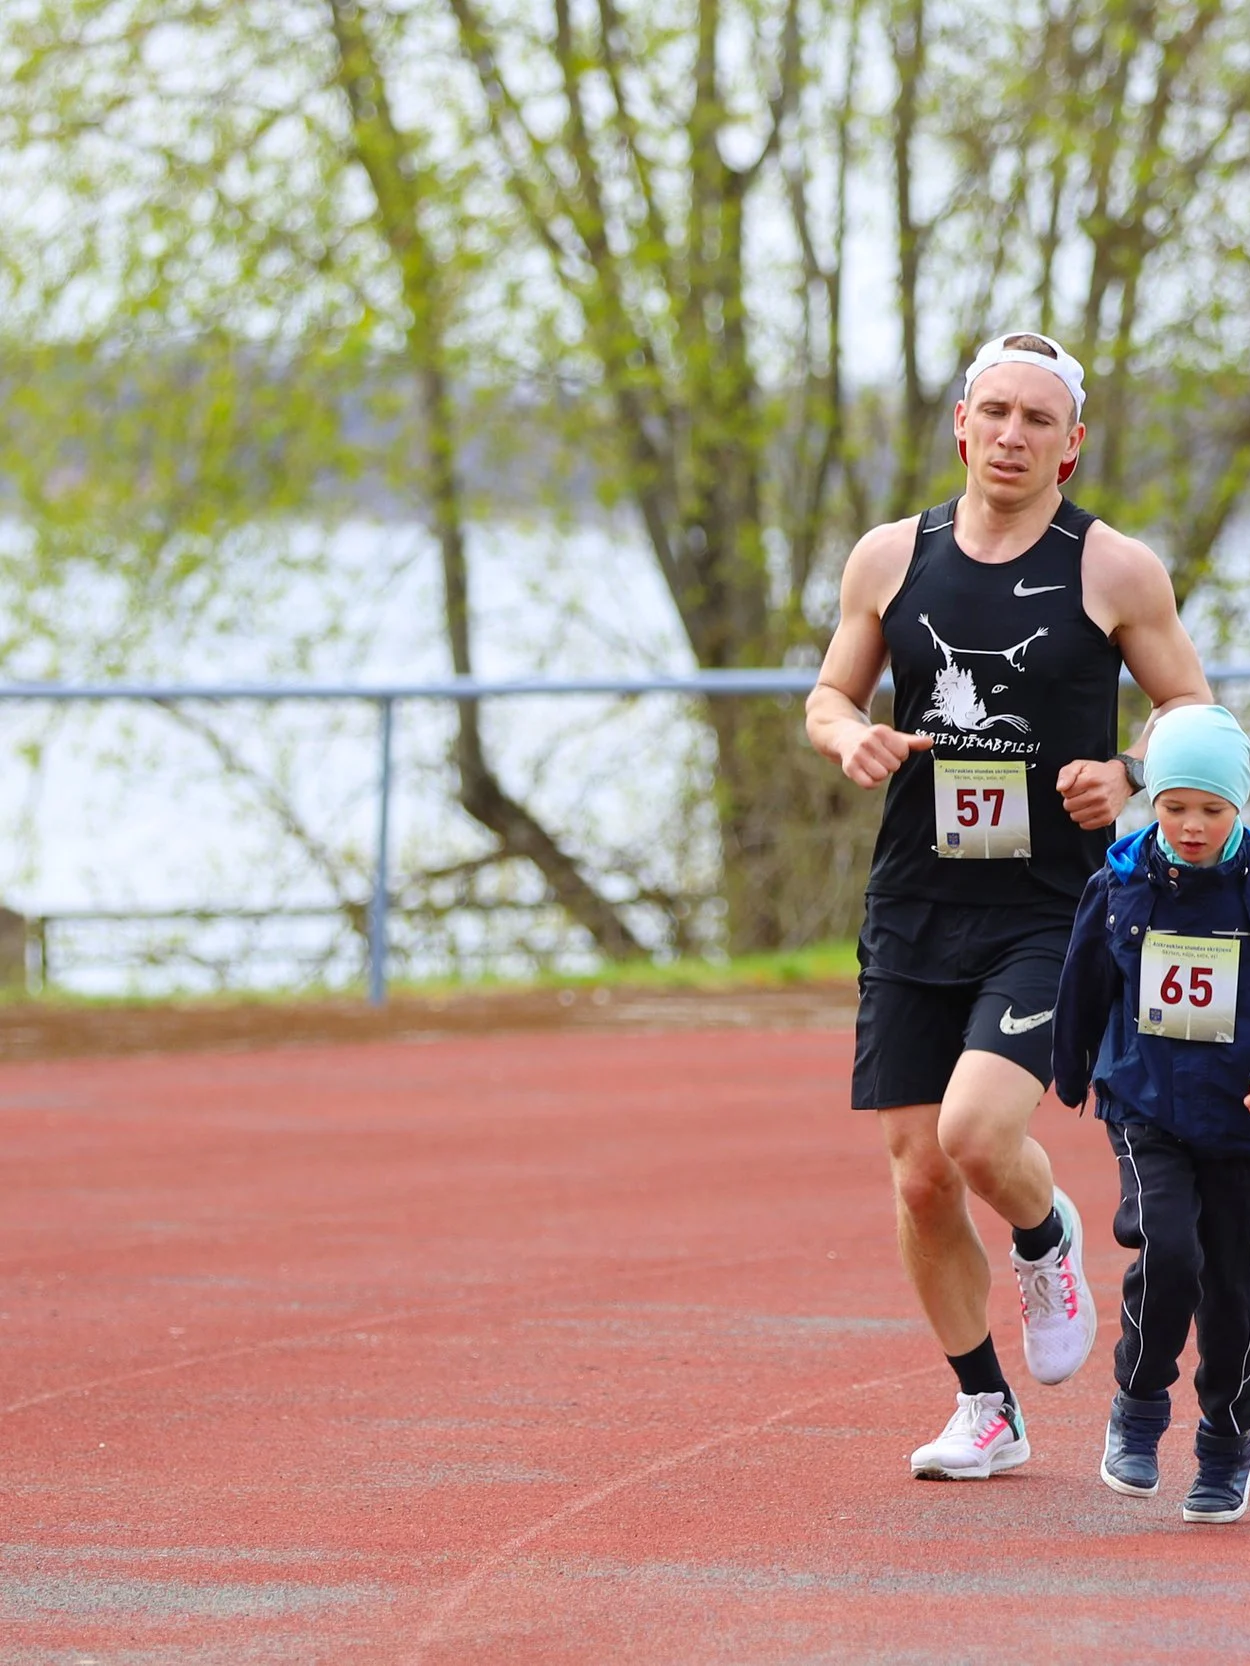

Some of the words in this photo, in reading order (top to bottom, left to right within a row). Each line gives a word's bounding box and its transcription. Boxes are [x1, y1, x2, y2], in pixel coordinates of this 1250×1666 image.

[957, 733, 1040, 754] JĒKABPILS!
[956, 789, 1005, 827] 57
[1160, 965, 1213, 1008] 65
